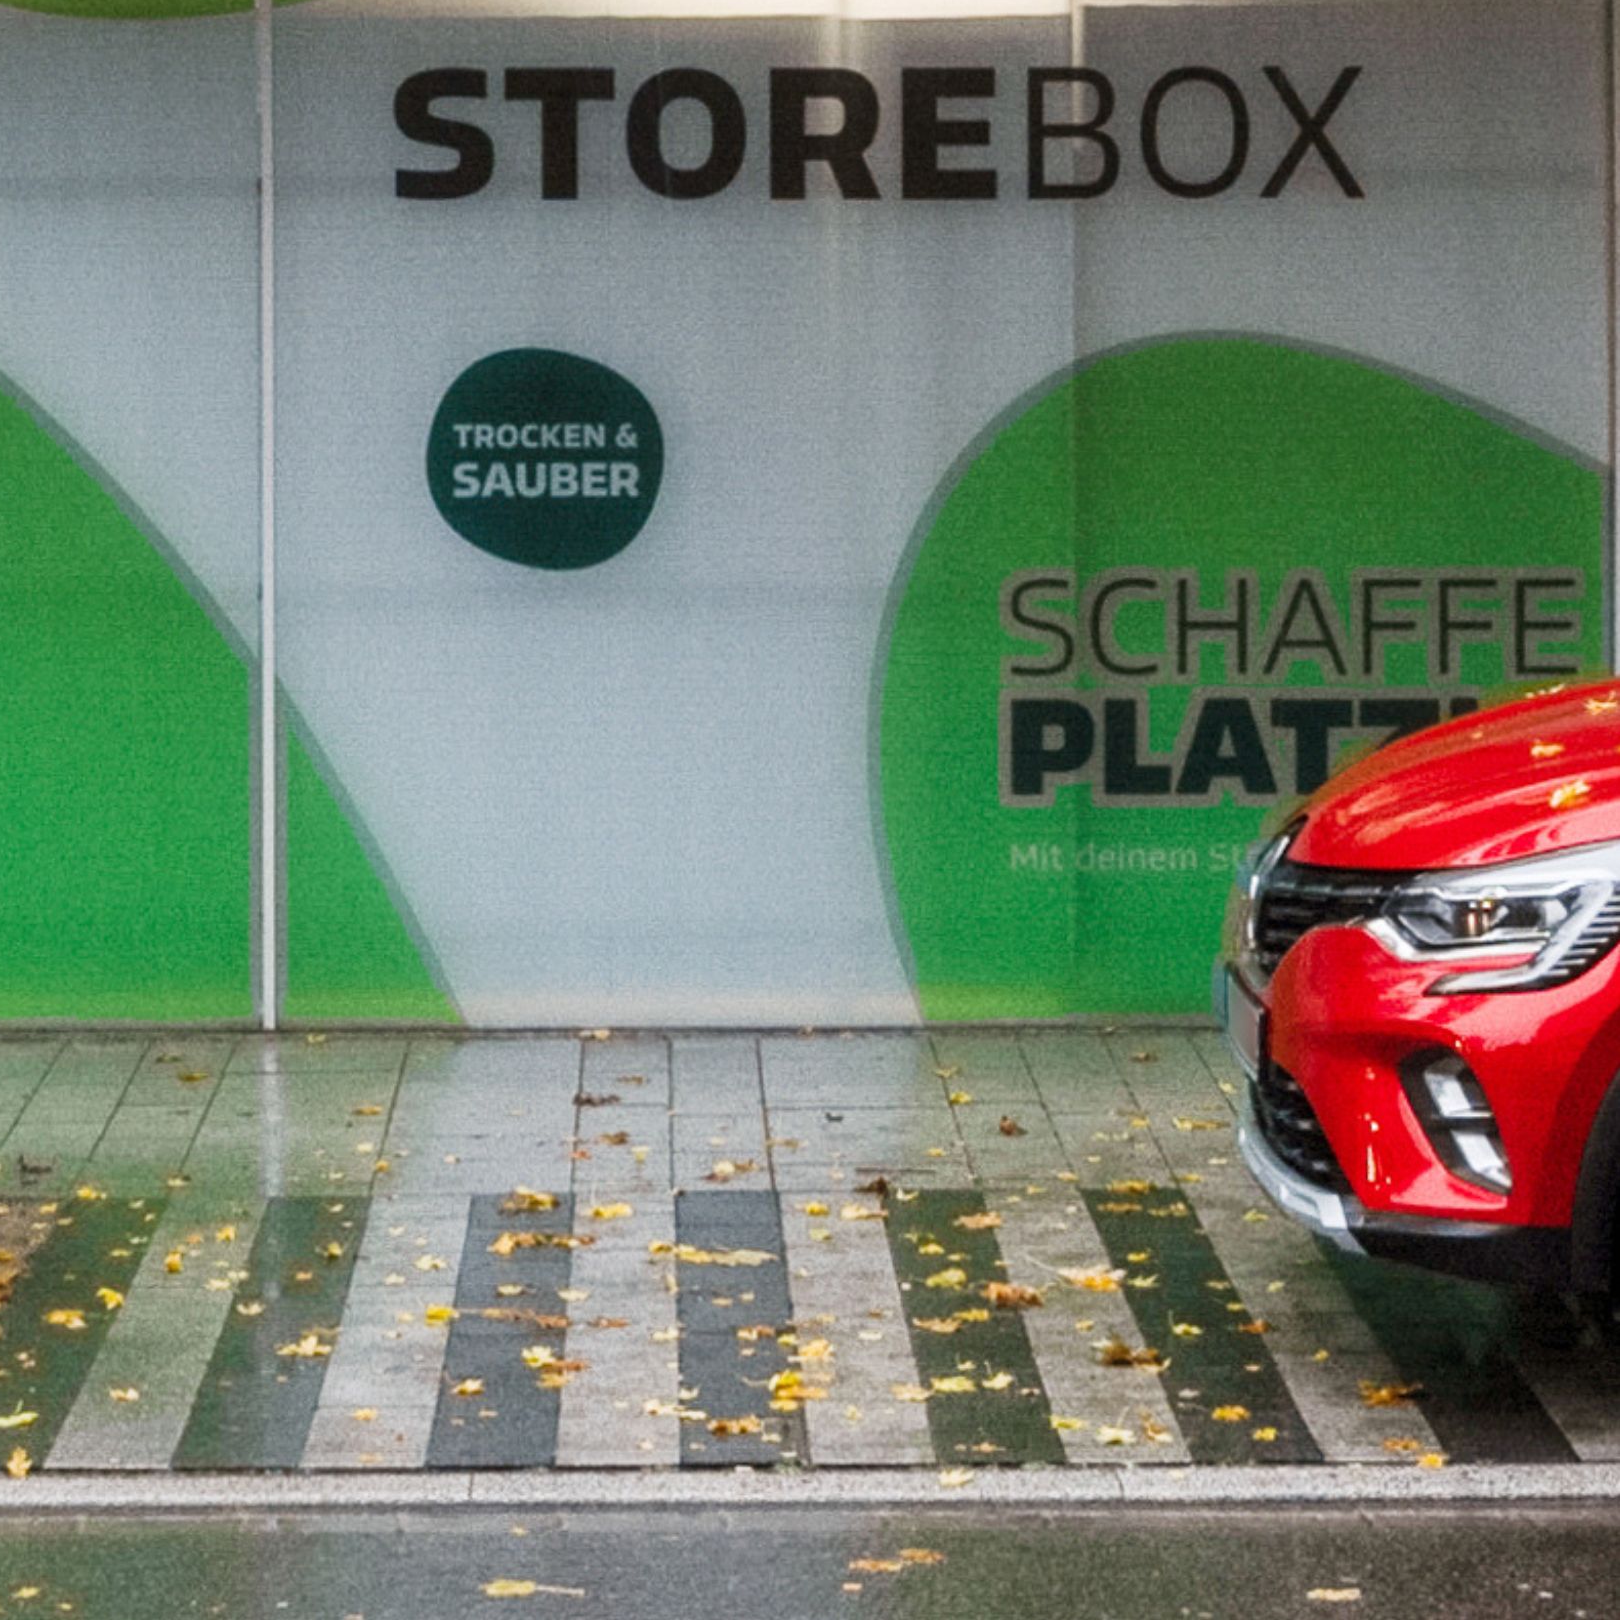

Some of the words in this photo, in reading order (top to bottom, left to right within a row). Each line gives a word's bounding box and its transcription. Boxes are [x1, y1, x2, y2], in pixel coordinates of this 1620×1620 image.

[393, 65, 1365, 200] STOREBOX
[453, 422, 606, 449] TROCKEN
[614, 422, 638, 449] &
[452, 459, 641, 499] SAUBER
[1010, 576, 1578, 676] SCHAFFE
[1010, 697, 1480, 795] PLAT
[1010, 843, 1064, 872] Mit
[1074, 842, 1198, 872] deinem
